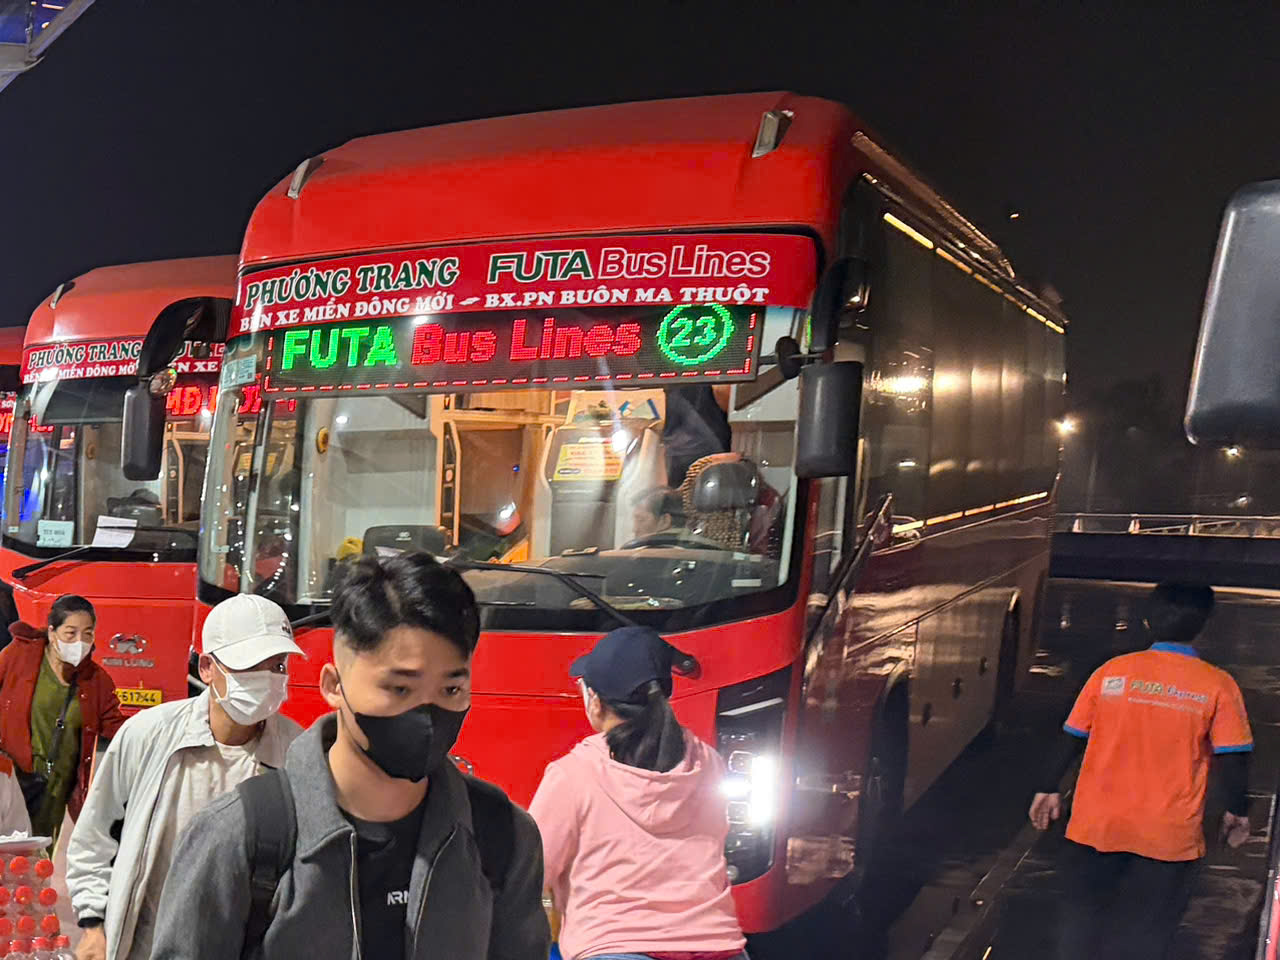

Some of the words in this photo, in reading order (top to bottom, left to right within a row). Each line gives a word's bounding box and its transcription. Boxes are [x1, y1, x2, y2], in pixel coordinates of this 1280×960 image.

[243, 266, 351, 310] PHƯƠNG
[355, 257, 460, 295] TRANG
[487, 249, 594, 284] FUTA
[598, 247, 667, 280] Bus
[668, 245, 770, 278] Lines
[277, 310, 300, 324] XE
[355, 295, 410, 317] ĐÔNG
[484, 289, 554, 308] BX.PN
[559, 284, 628, 305] BUÔN
[634, 287, 673, 303] MA
[679, 282, 769, 305] THUỘT
[281, 325, 397, 371] FUTA
[411, 323, 497, 366] Bus
[510, 316, 642, 361] Lines
[670, 315, 718, 348] 23
[28, 343, 85, 369] PHƯƠNG
[88, 340, 142, 363] TRANG
[193, 360, 218, 372] XE
